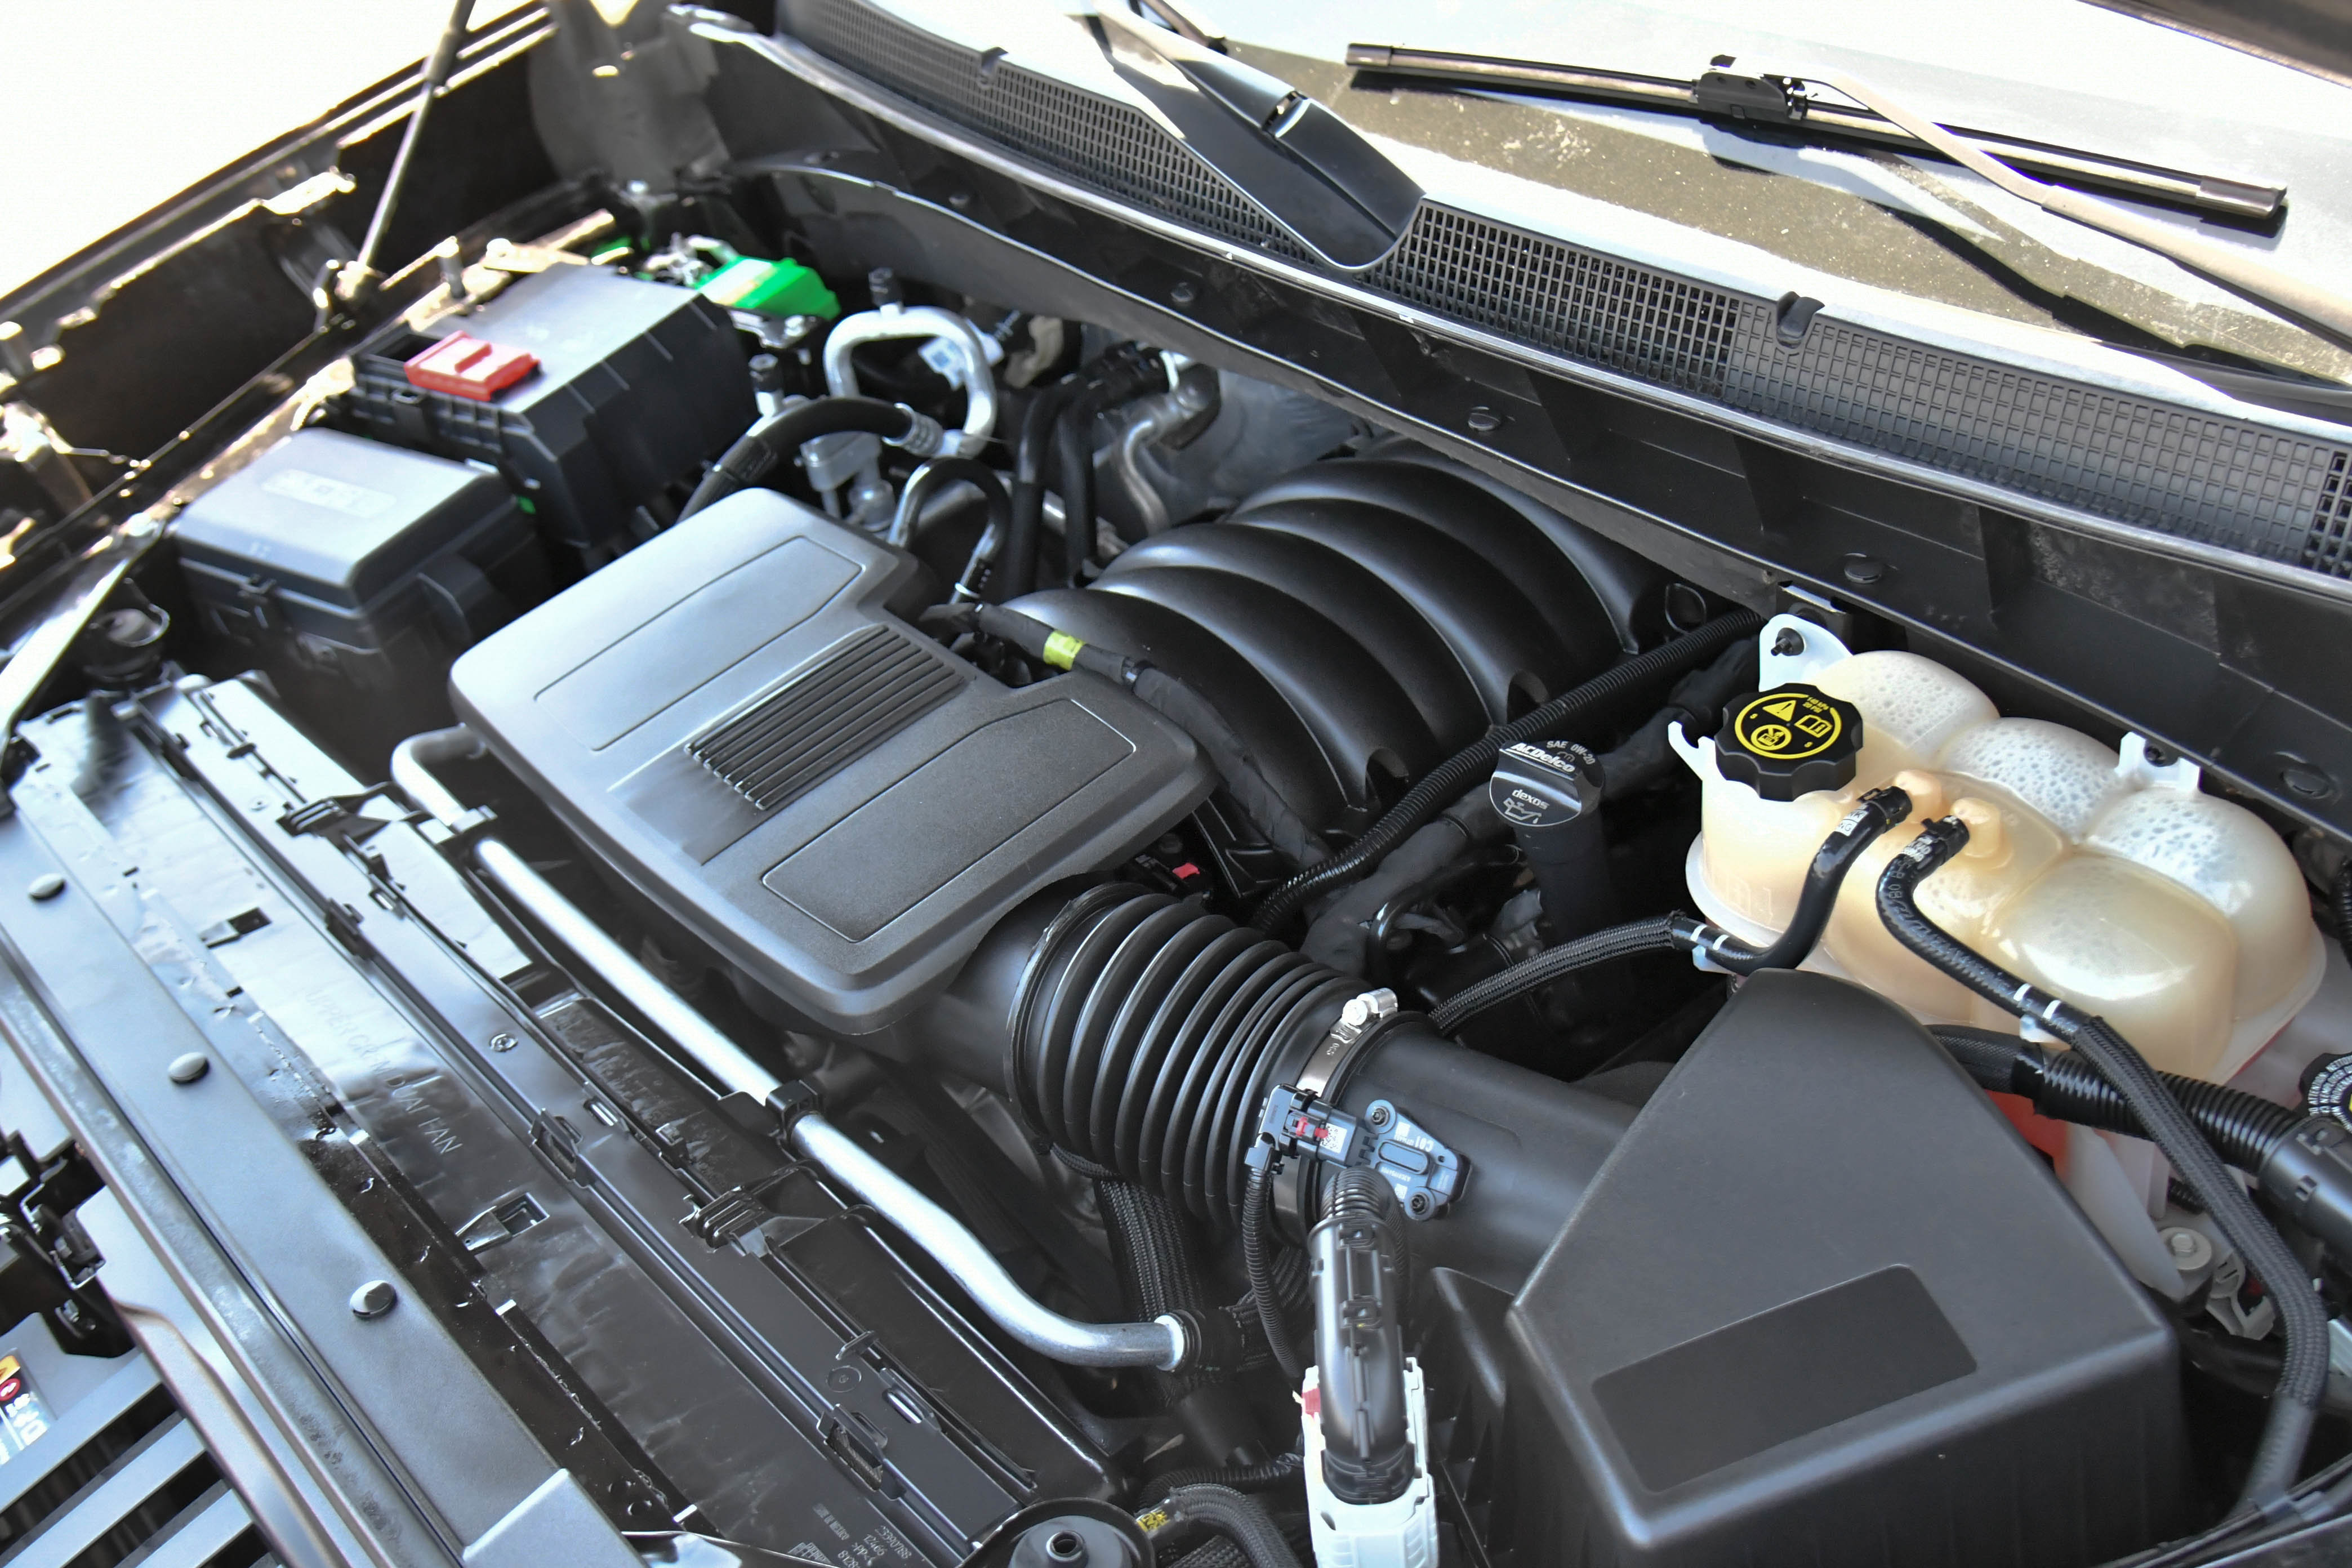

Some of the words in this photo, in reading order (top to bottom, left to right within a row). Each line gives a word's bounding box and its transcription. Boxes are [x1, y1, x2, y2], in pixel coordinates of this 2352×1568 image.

[1510, 742, 1576, 773] ACDelco
[1547, 741, 1569, 749] SAE
[1570, 743, 1596, 765] 0W-20
[1512, 789, 1550, 810] dexos
[863, 1534, 888, 1556] 12466
[874, 1525, 912, 1559] 23390788
